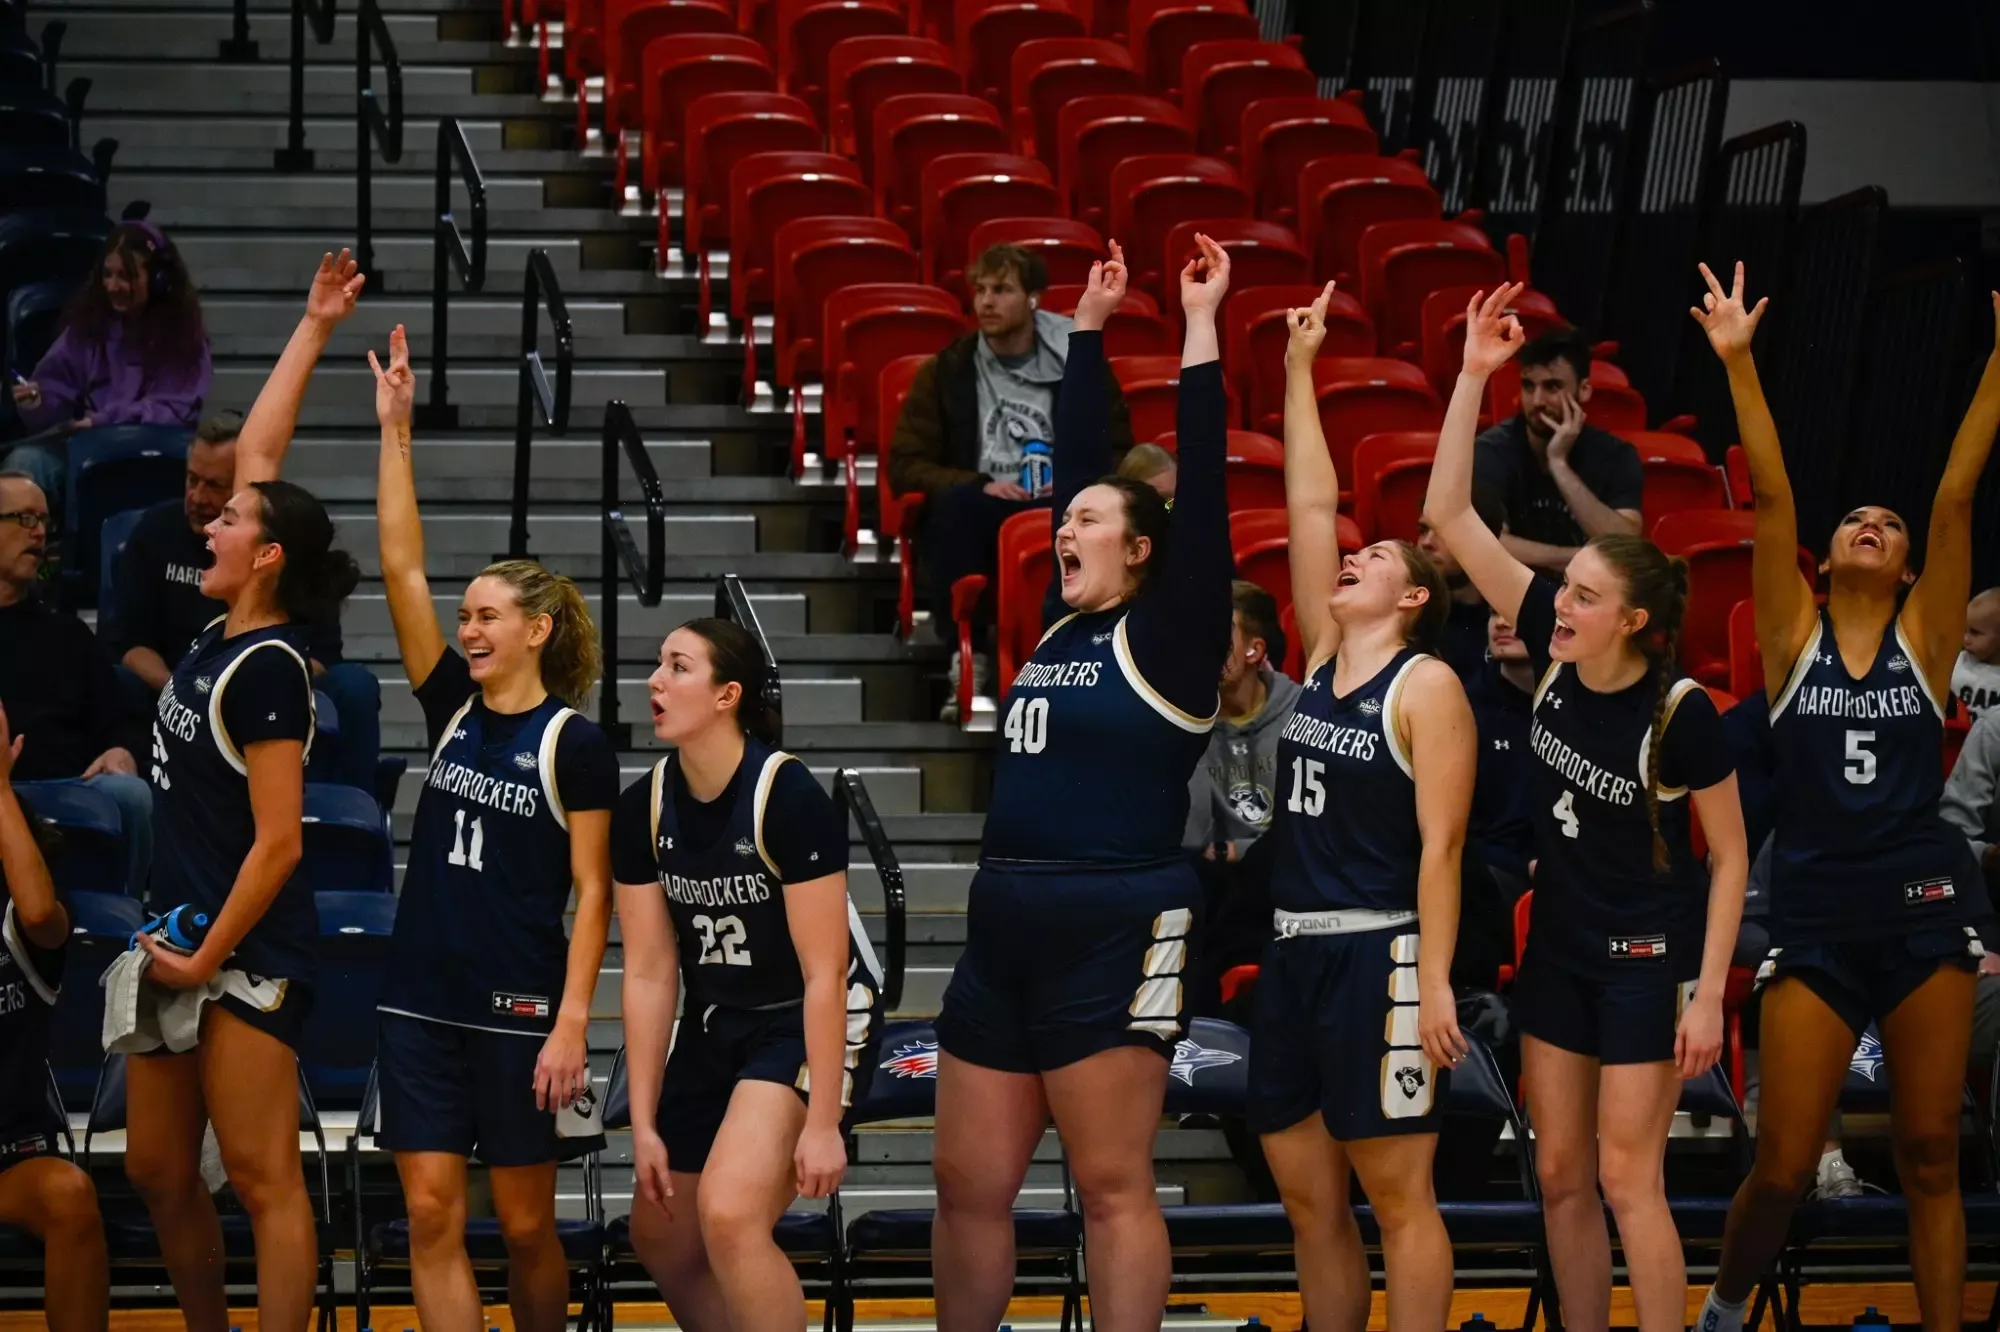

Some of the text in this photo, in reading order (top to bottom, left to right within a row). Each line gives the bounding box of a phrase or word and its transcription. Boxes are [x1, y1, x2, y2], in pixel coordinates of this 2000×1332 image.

[1004, 697, 1050, 754] 40
[1797, 686, 1921, 719] HARDROCKERS
[1529, 715, 1637, 806] HARDROCKERS
[1844, 729, 1877, 784] 5
[1287, 755, 1326, 818] 15
[1552, 789, 1580, 839] 4
[448, 808, 484, 872] 11
[692, 914, 752, 966] 22
